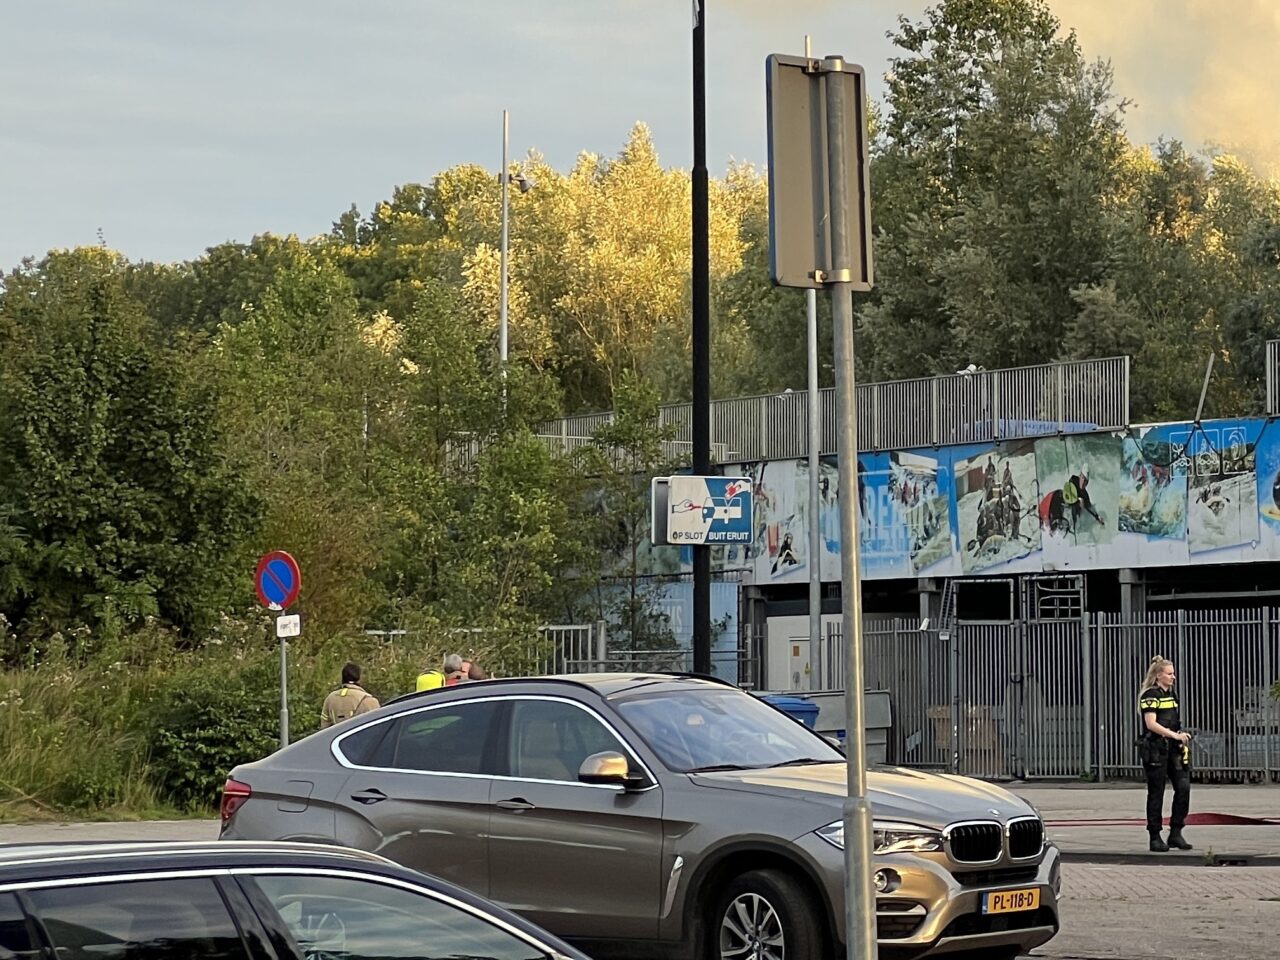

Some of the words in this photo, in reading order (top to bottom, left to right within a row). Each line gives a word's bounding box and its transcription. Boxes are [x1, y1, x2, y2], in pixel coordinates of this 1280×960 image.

[672, 531, 683, 540] OP
[685, 531, 704, 540] SLOT
[708, 531, 726, 540] BUIT
[727, 531, 749, 540] ERUIT
[993, 891, 1034, 910] PL-118-D
